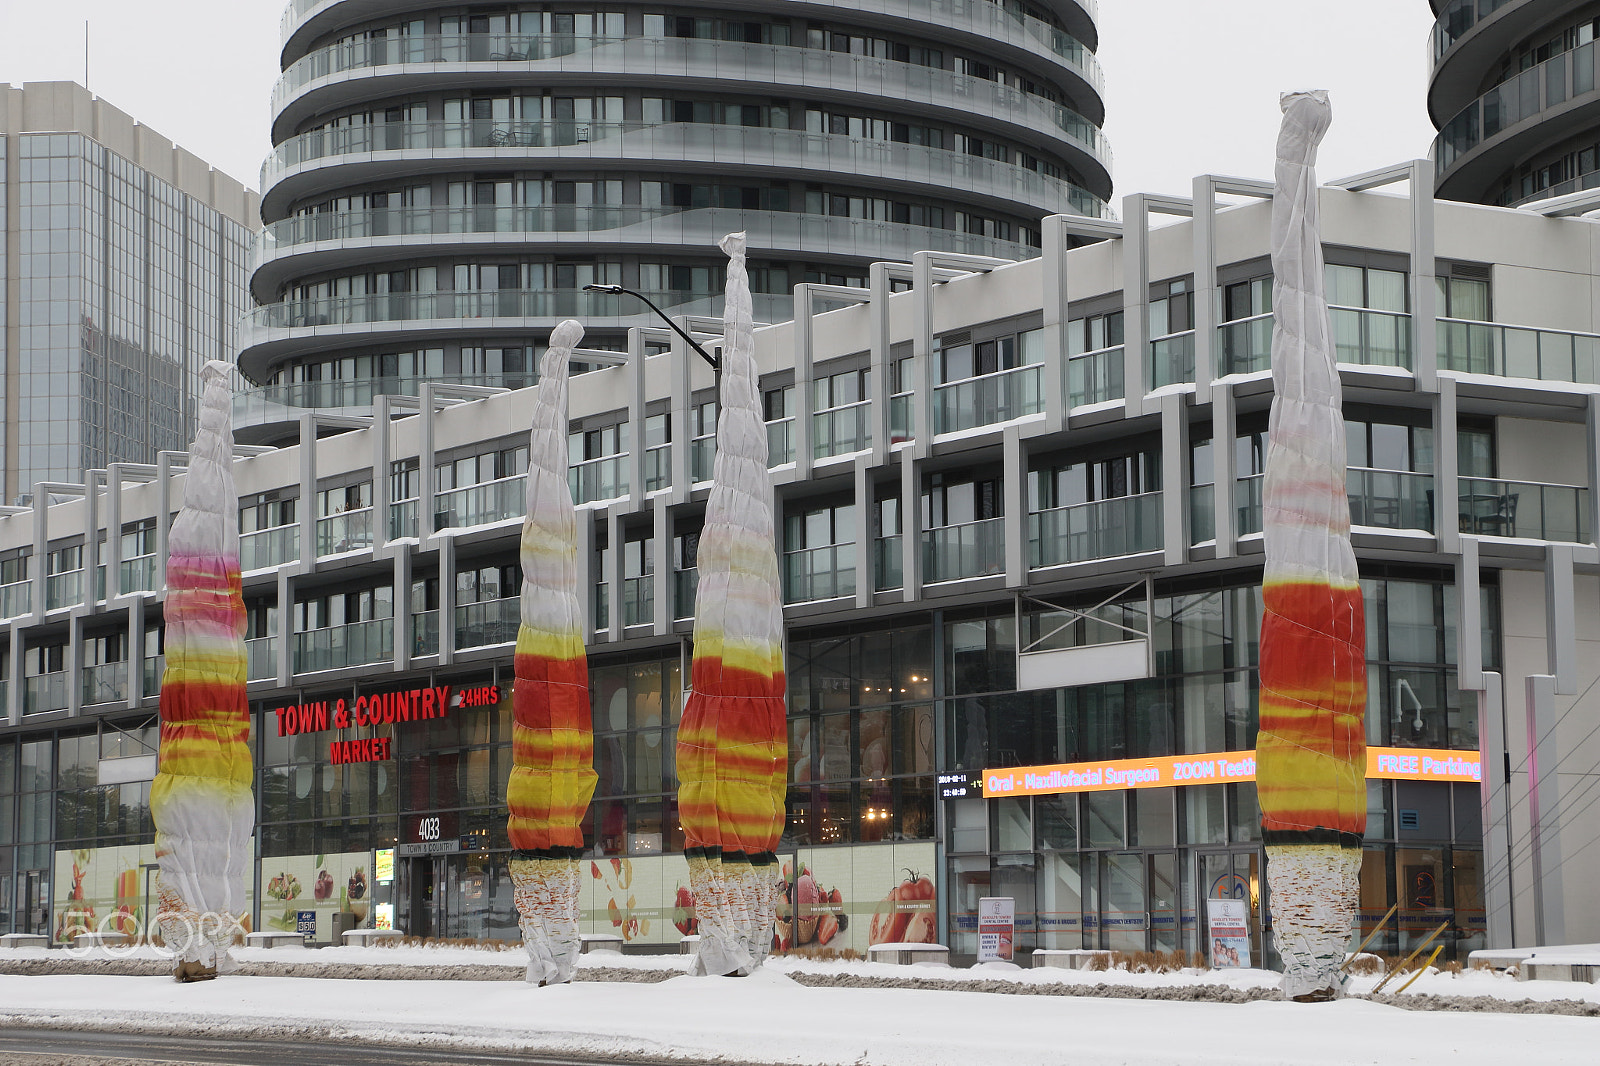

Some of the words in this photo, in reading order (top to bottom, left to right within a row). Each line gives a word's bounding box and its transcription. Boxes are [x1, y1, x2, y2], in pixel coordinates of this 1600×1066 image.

[275, 701, 329, 737] TOWN
[335, 698, 351, 729] &
[355, 685, 452, 727] COUNTRY
[459, 685, 500, 708] 24HRS
[330, 737, 390, 765] MARKET
[988, 774, 1014, 792] Oral
[1024, 768, 1102, 789] Maxillofacial
[1105, 767, 1160, 786] Surgeon
[1173, 760, 1214, 780] ZOOM
[1217, 758, 1257, 776] Teeth
[1378, 755, 1418, 773] FREE
[1422, 756, 1481, 779] Parking
[418, 817, 440, 840] 4033
[406, 844, 422, 853] TOWN
[428, 842, 454, 852] COUNTRY
